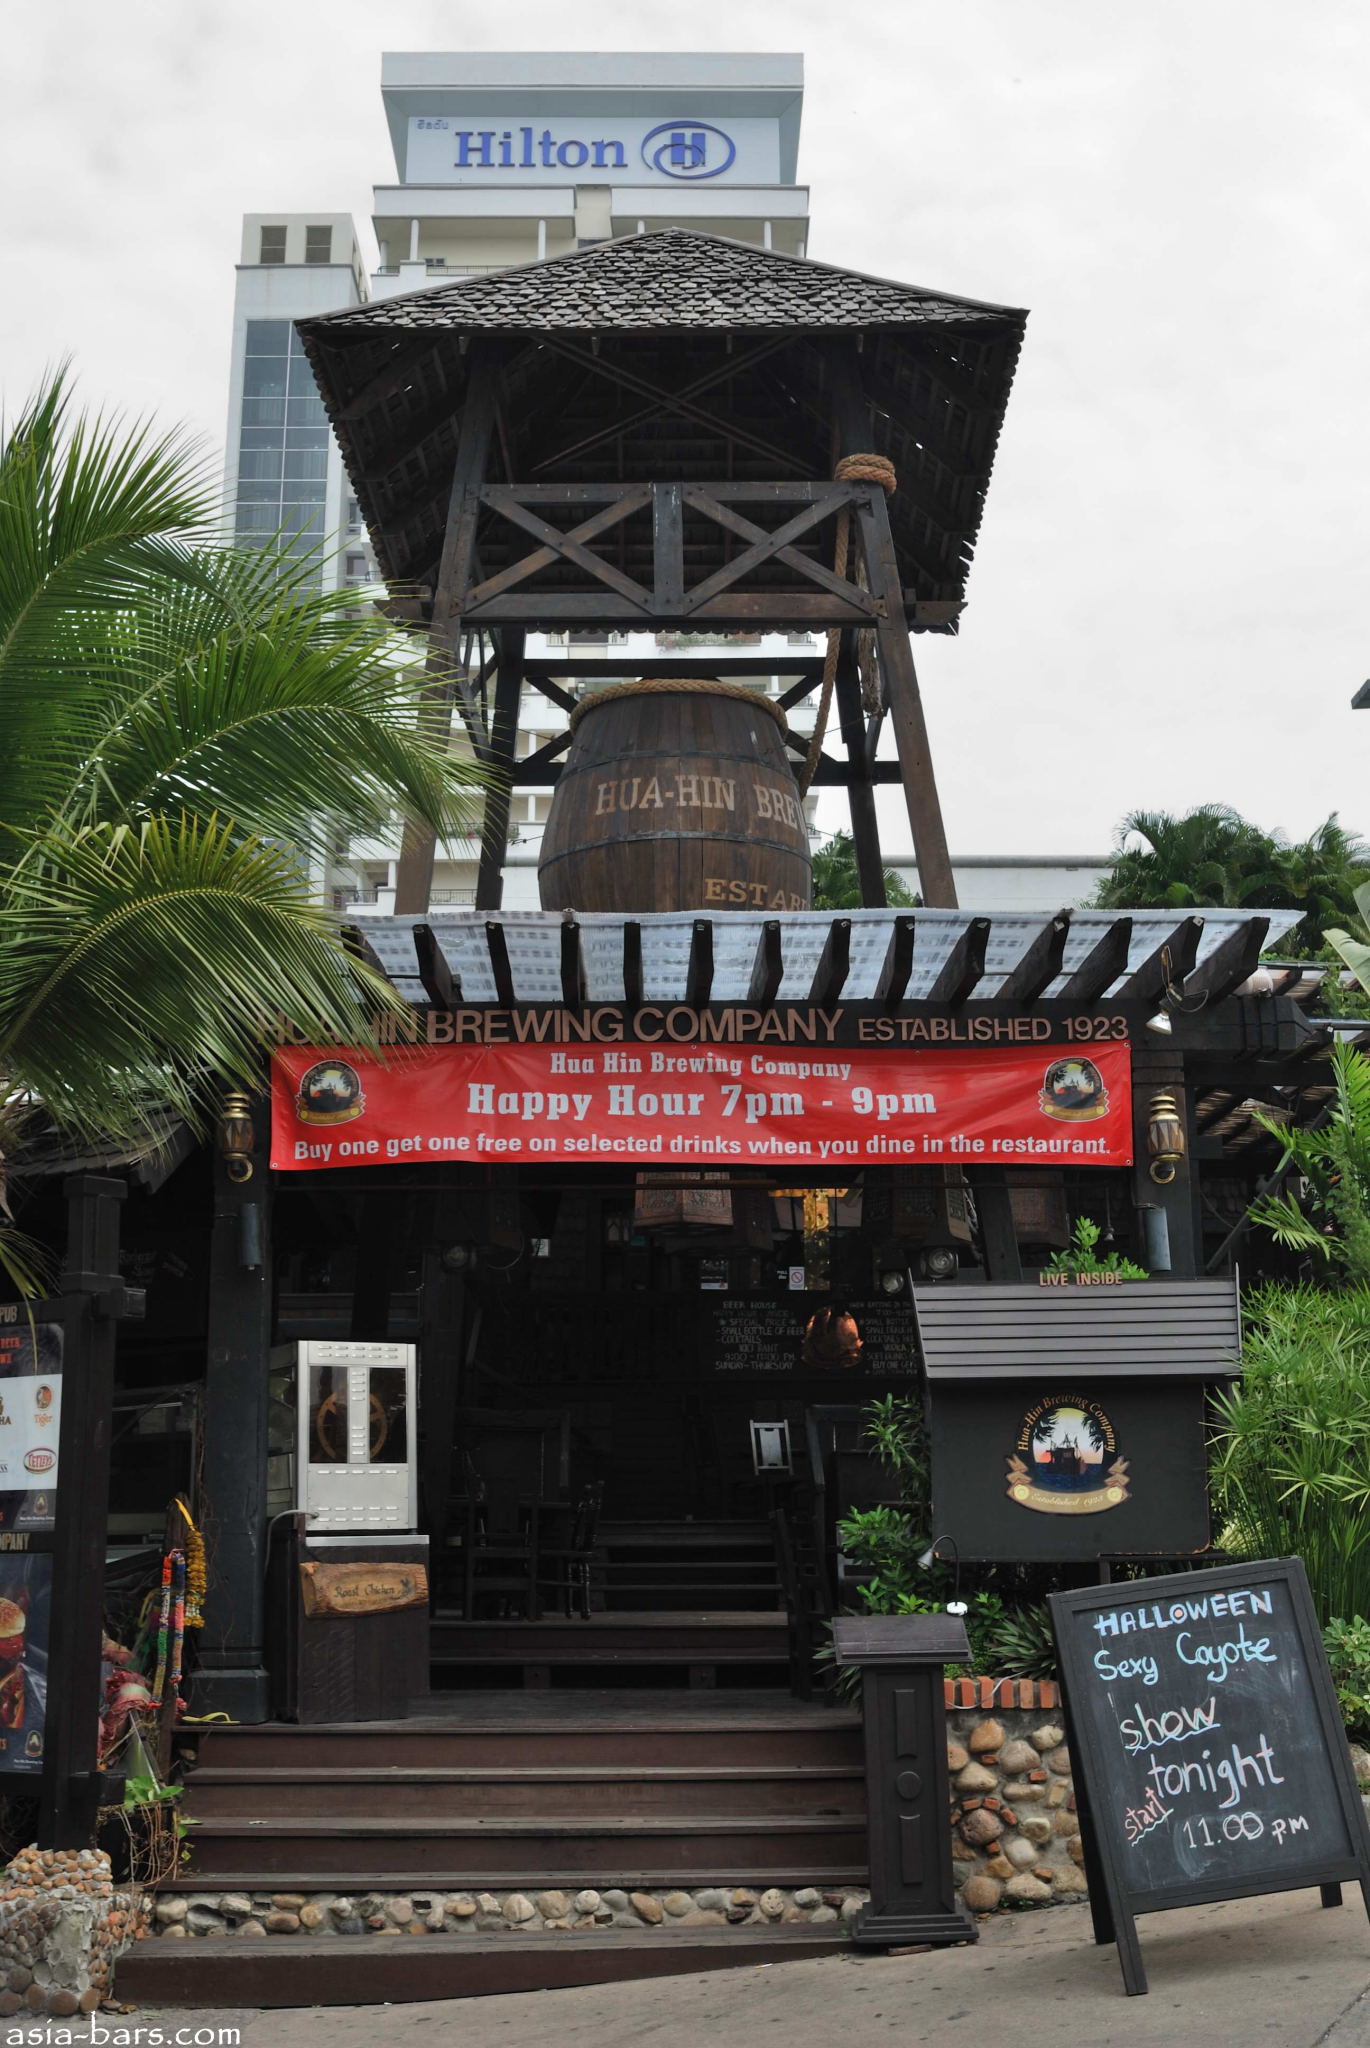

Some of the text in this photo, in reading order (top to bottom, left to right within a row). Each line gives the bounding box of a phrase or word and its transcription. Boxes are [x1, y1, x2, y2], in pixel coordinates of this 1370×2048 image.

[454, 127, 629, 168] Hilton
[595, 774, 736, 816] HUA-HIN
[427, 1007, 624, 1043] BREWING
[633, 1006, 845, 1042] COMPANY
[858, 1016, 1052, 1041] ESTABLISHED
[1062, 1016, 1129, 1041] 1923
[550, 1051, 852, 1081] Hua Hin Brewing Company
[467, 1083, 593, 1121] Happy
[607, 1084, 705, 1116] Hour
[720, 1084, 805, 1124] 7pm
[851, 1086, 937, 1121] 9pm
[294, 1133, 1111, 1162] Buy one get one free on selected drinks when you dine in the restaurant.
[1039, 1271, 1123, 1287] LIVE INSIDE
[1018, 1394, 1117, 1453] Hua-Hin Brewing Company
[1093, 1590, 1273, 1637] HALLOWEEN
[1093, 1622, 1278, 1686] Sexy Coyote
[1120, 1696, 1216, 1747] show
[1147, 1733, 1285, 1809] tonight
[1124, 1786, 1168, 1841] start
[1183, 1811, 1265, 1849] 11.00
